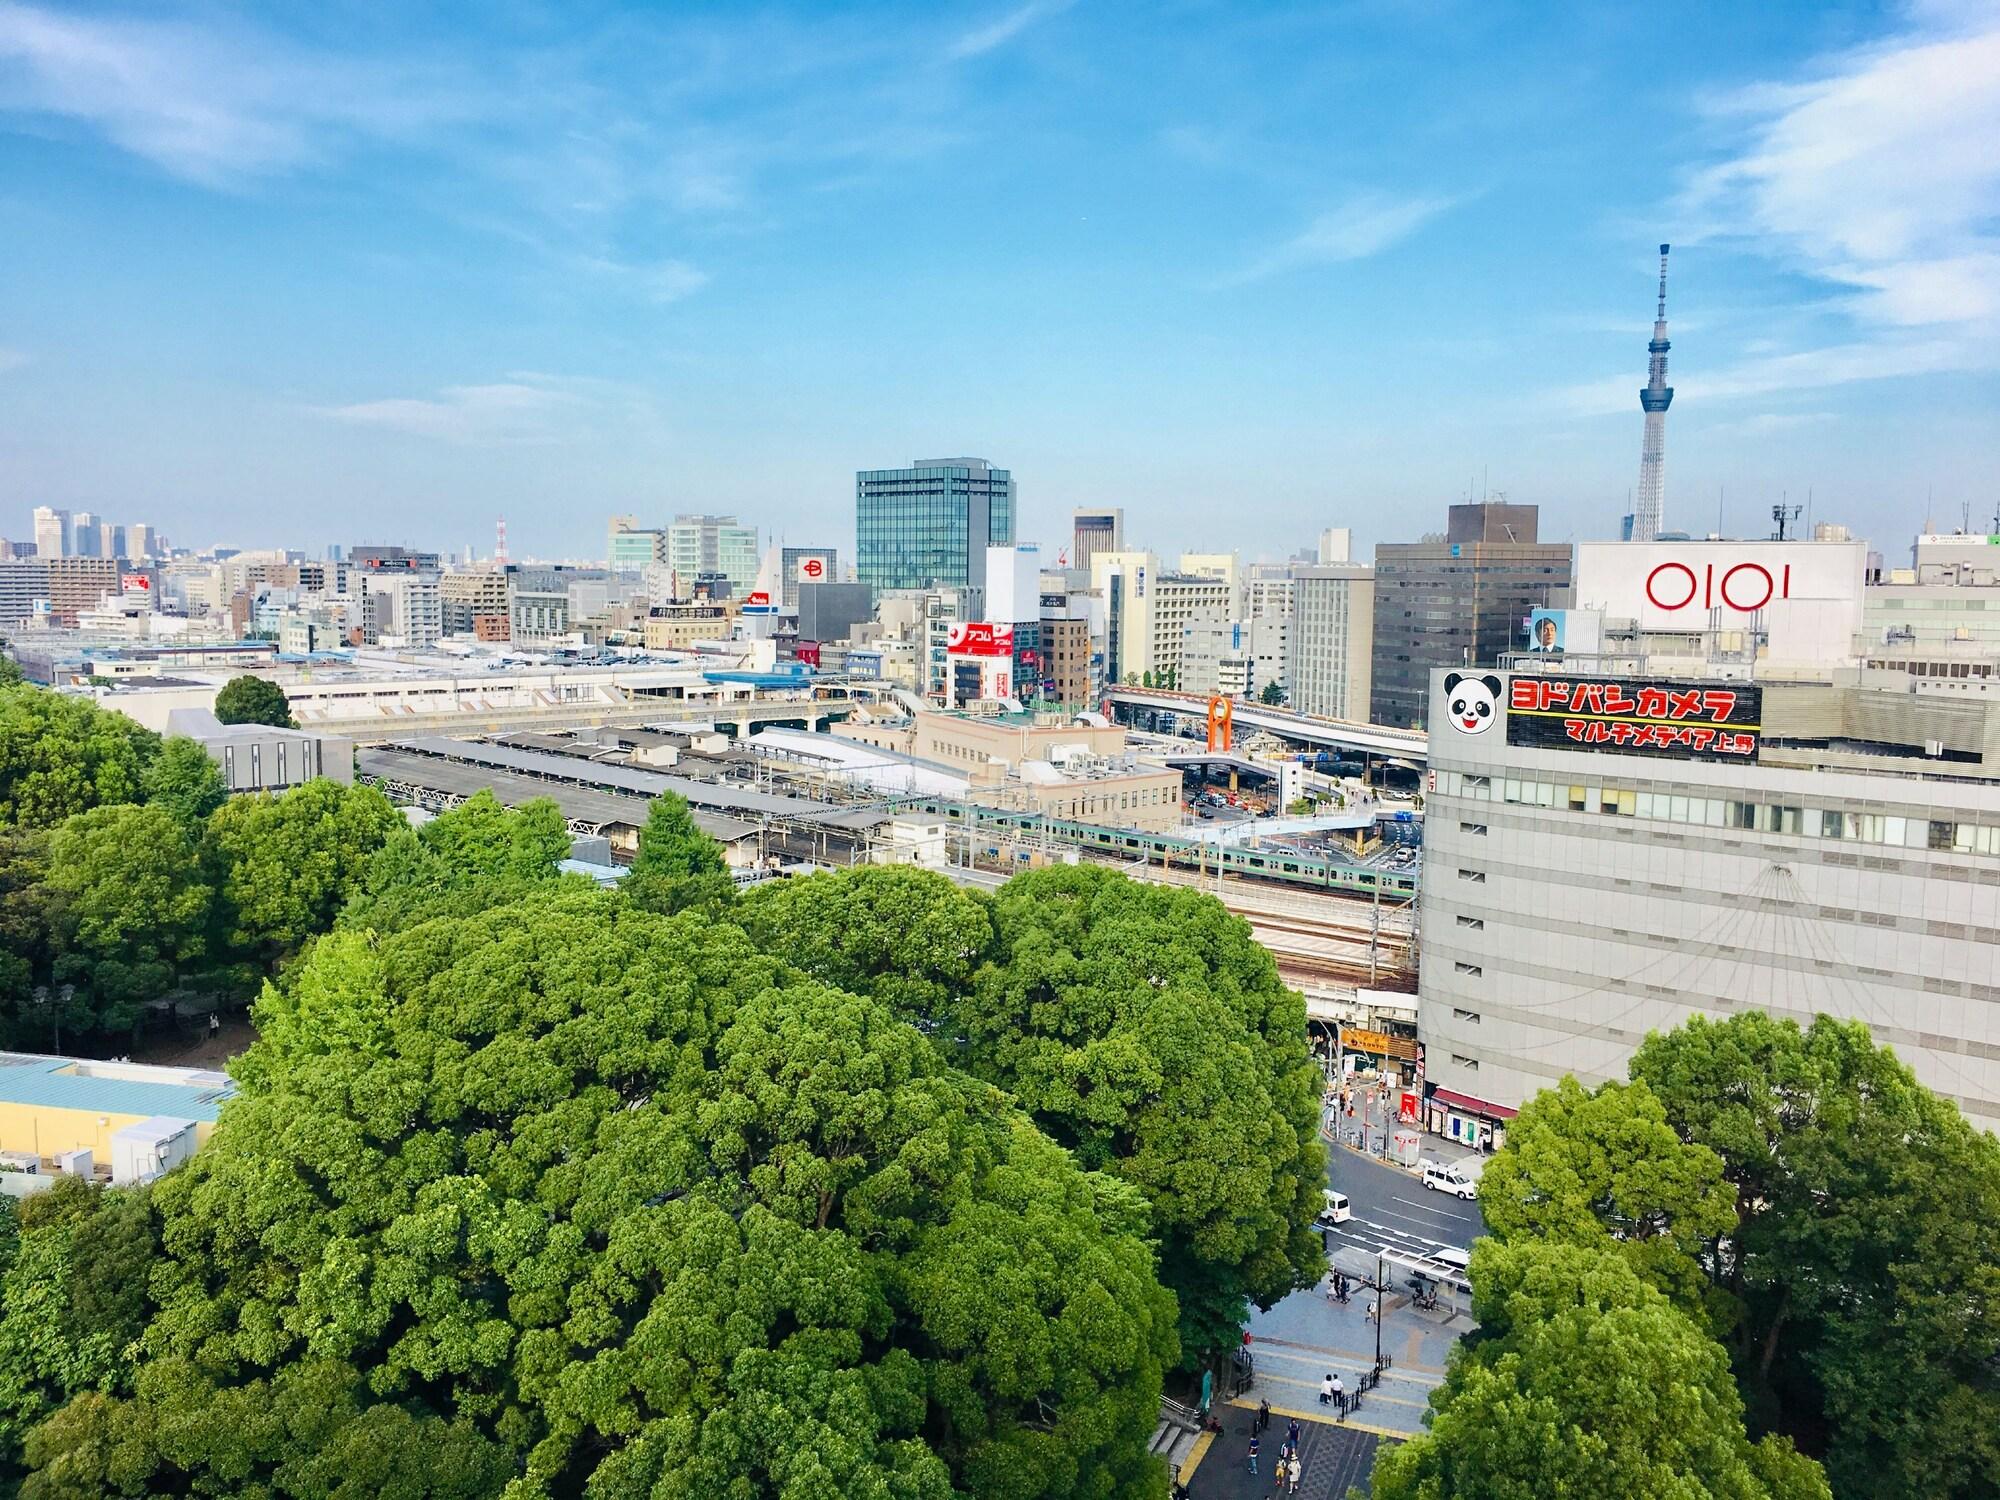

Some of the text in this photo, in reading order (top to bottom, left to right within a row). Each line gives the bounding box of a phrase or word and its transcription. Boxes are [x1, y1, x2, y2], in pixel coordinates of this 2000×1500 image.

[968, 630, 992, 642] アコム
[1511, 679, 1736, 722] ヨドバシカメラ
[1564, 719, 1755, 755] マルチメディア上野
